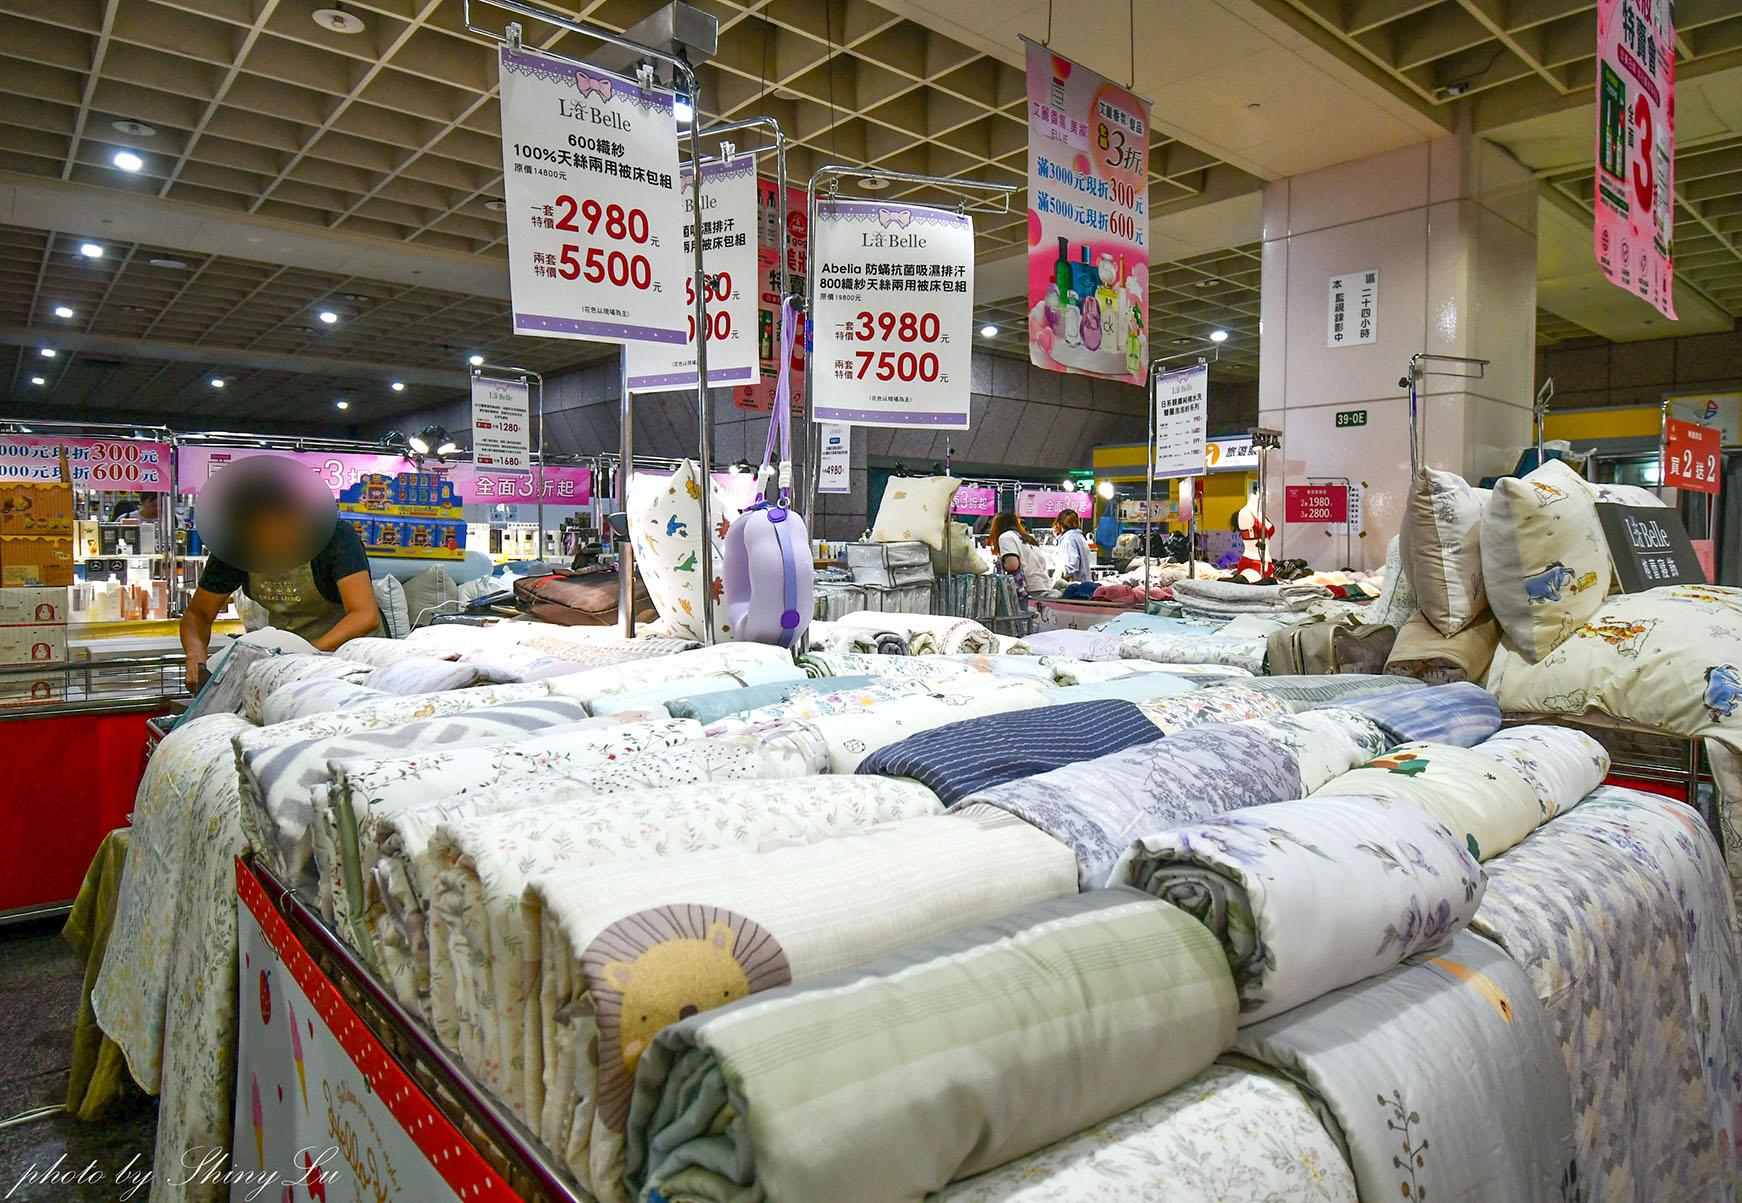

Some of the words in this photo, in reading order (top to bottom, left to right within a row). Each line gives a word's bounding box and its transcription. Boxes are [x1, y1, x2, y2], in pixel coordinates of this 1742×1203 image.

[590, 107, 632, 132] Belle
[568, 134, 625, 158] 600織紗
[513, 143, 673, 190] 100%天絲兩用被床包組
[514, 163, 567, 181] 原價14800元
[1037, 155, 1143, 215] 滿3000元現折300元
[530, 204, 554, 217] 一套
[684, 195, 717, 213] Blle
[531, 216, 554, 230] 特價
[1037, 190, 1143, 246] 滿5000元現折600元
[889, 234, 927, 248] Belle
[533, 252, 556, 266] 兩套
[534, 266, 557, 279] 特價
[821, 263, 862, 275] Abelia
[865, 263, 966, 277] 防蟎抗菌吸濕排汗
[819, 278, 967, 293] 800織紗天絲兩用被床包組
[819, 293, 862, 302] 原價19800元
[835, 321, 854, 331] 一套
[835, 330, 854, 341] 特價
[834, 360, 854, 370] 兩套
[834, 370, 853, 380] 特價
[499, 423, 518, 432] 1280
[500, 457, 519, 466] 1680
[1639, 520, 1671, 548] Belle
